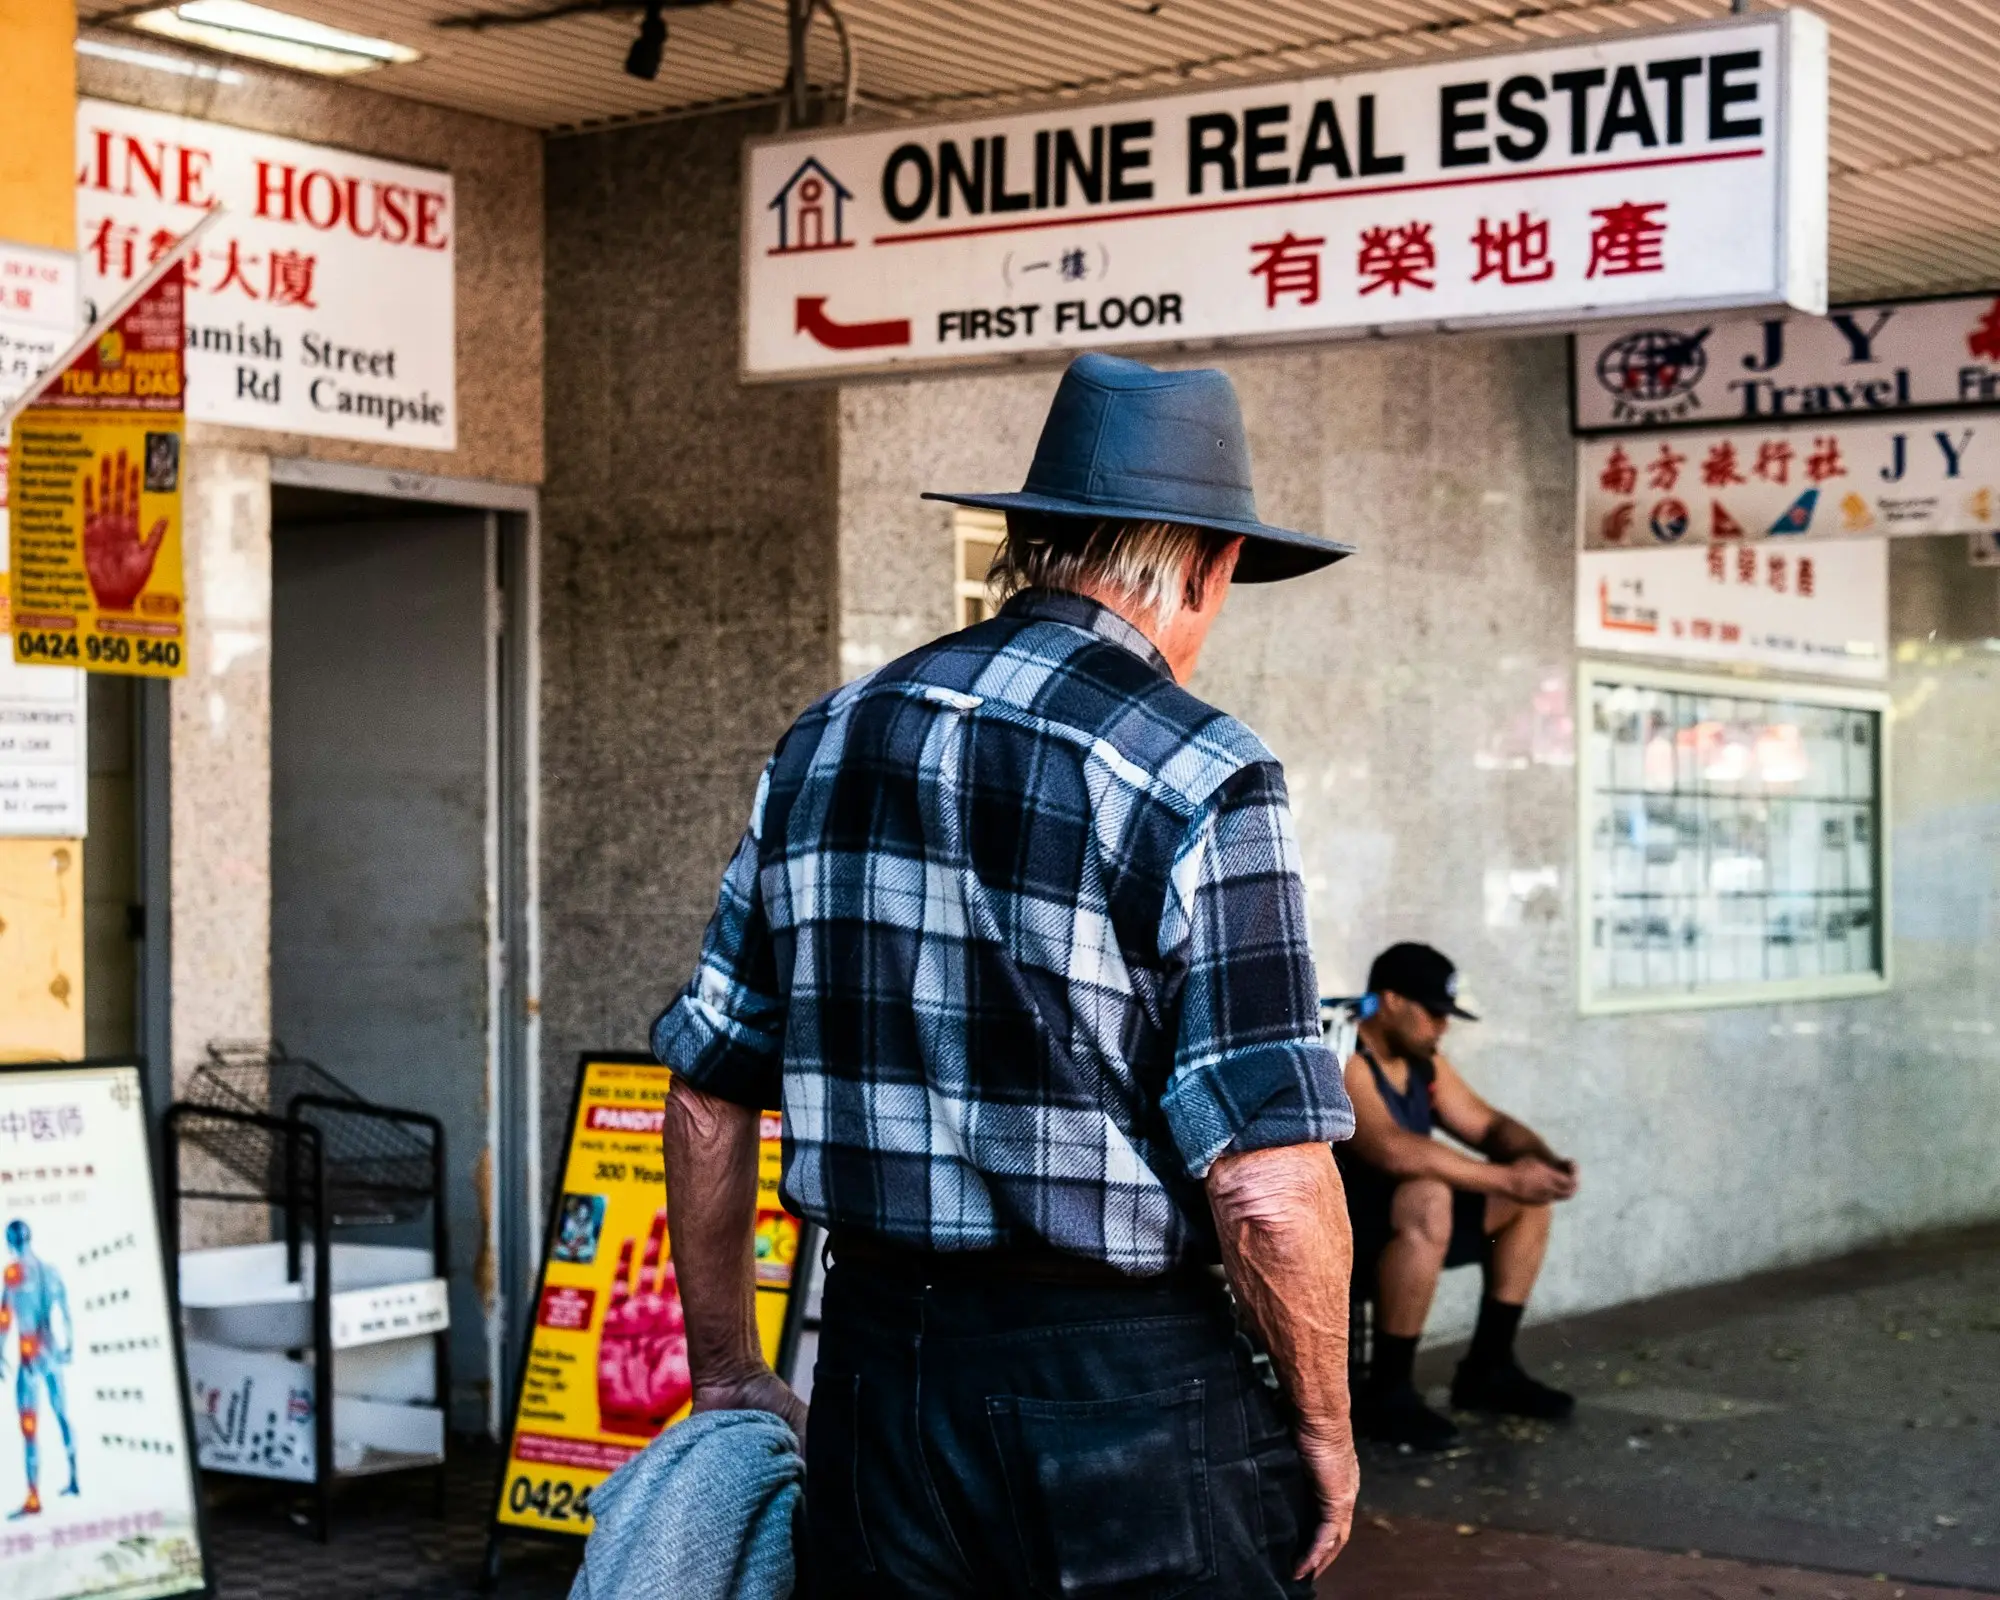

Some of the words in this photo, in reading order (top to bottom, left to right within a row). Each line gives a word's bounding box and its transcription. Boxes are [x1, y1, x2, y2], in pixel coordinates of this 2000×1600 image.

[882, 120, 1154, 222] ONLINE
[1188, 93, 1405, 195] REAL
[1440, 50, 1763, 168] ESTATE
[77, 126, 215, 208] INE
[253, 158, 448, 252] HOUSE
[1250, 201, 1668, 309] 有榮地產
[938, 305, 1041, 343] FIRST
[1055, 292, 1182, 333] FLOOR
[1742, 320, 1784, 372] J
[1832, 309, 1896, 364] Y
[186, 322, 282, 360] amish
[301, 330, 396, 377] Street
[236, 366, 280, 404] Rd
[309, 377, 445, 428] Campsie
[1728, 367, 1910, 417] Travel
[1600, 437, 1847, 494] 南方旅行社
[1880, 433, 1908, 483] J
[1934, 428, 1973, 479] Y
[18, 631, 79, 658] 0424
[86, 634, 130, 663] 950
[136, 639, 180, 668] 540
